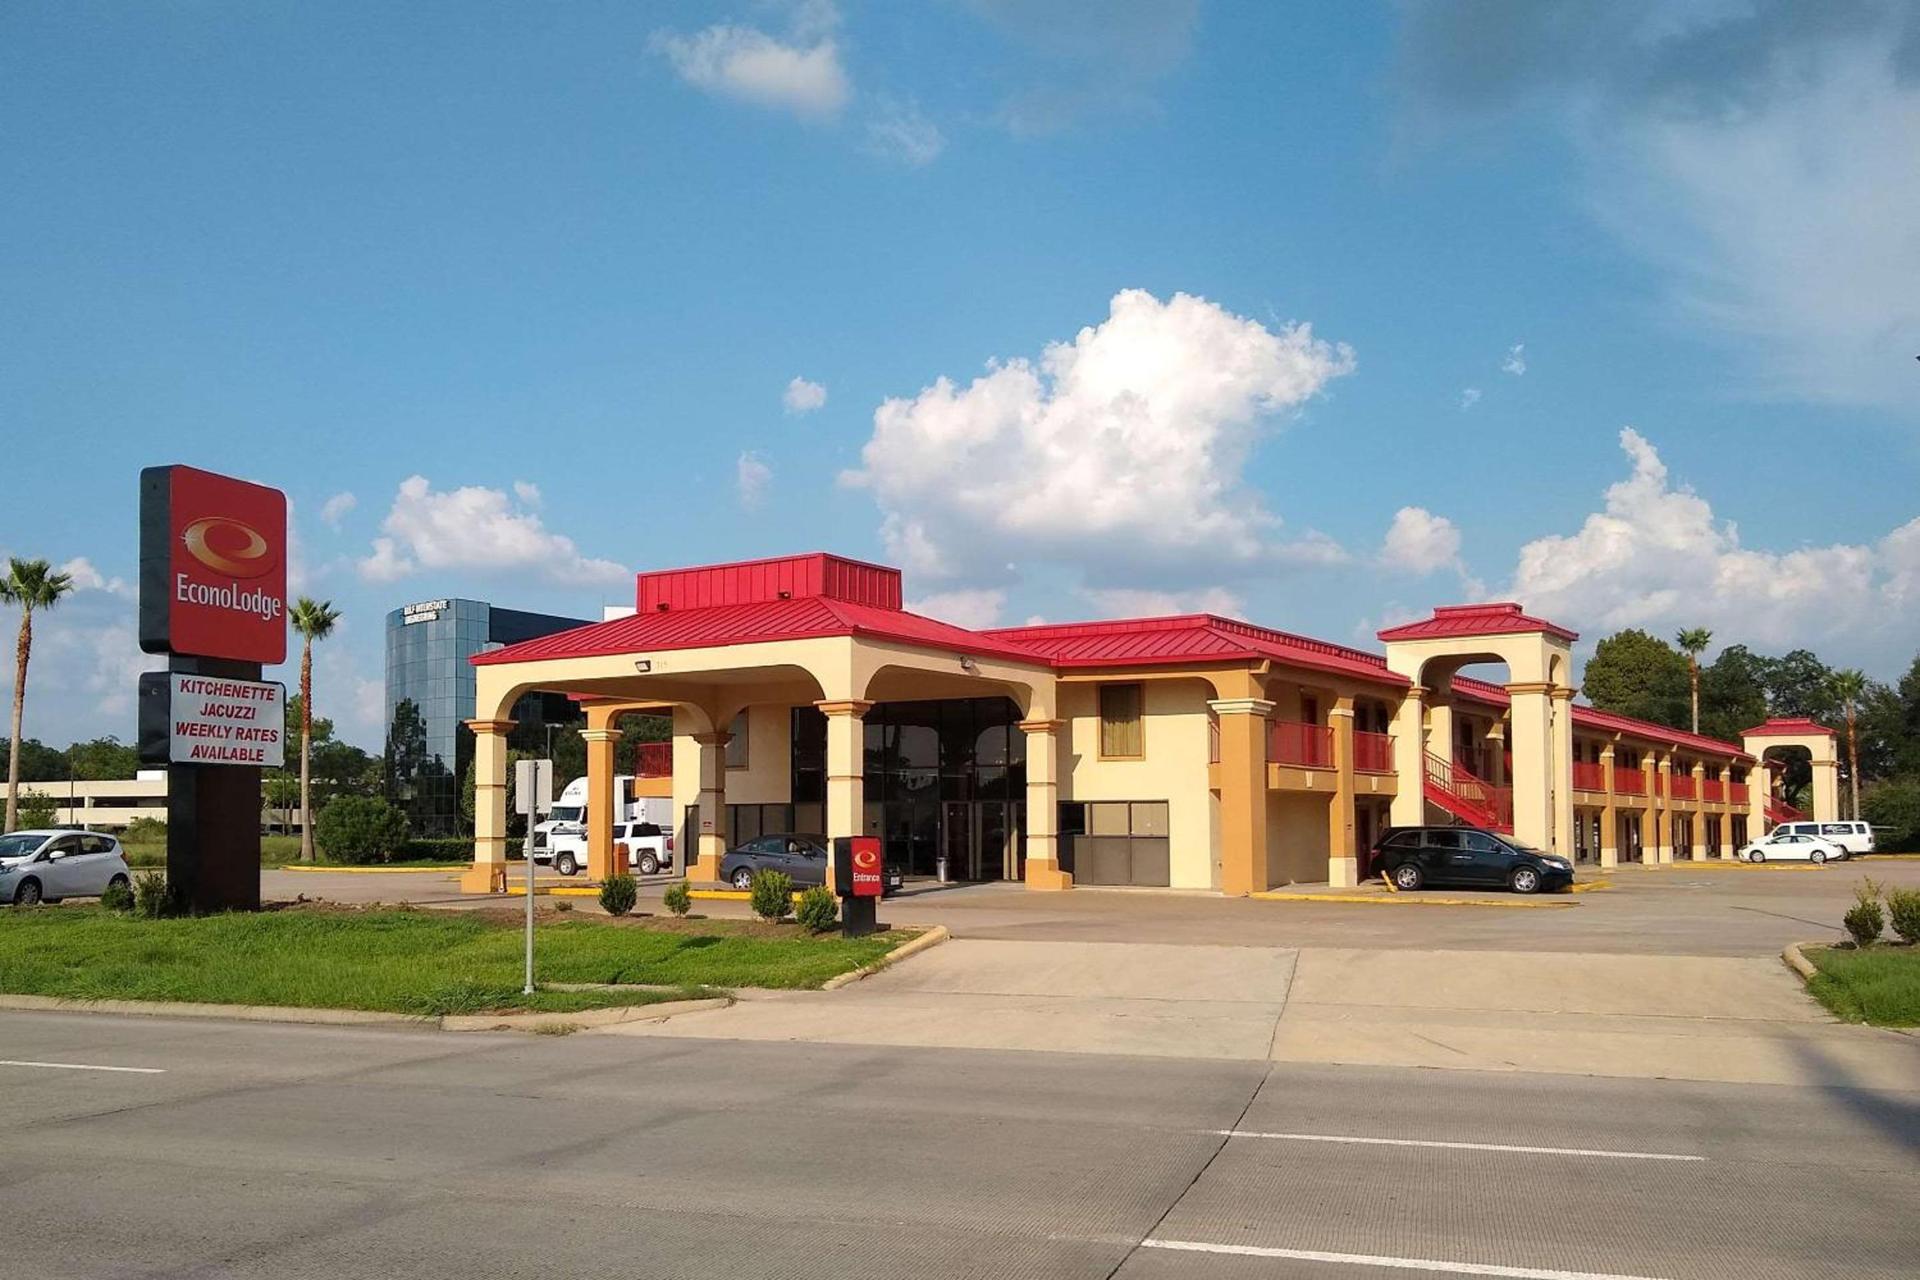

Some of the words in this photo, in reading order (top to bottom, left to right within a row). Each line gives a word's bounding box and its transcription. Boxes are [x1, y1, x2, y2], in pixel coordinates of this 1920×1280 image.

[177, 573, 281, 620] EconoLodge
[180, 679, 276, 701] KITCHENETTE
[200, 703, 257, 720] JACUZZI
[176, 721, 233, 739] WEEKLY
[235, 727, 279, 743] RATES
[190, 744, 264, 762] AVAILABLE
[853, 872, 880, 882] Entrance
